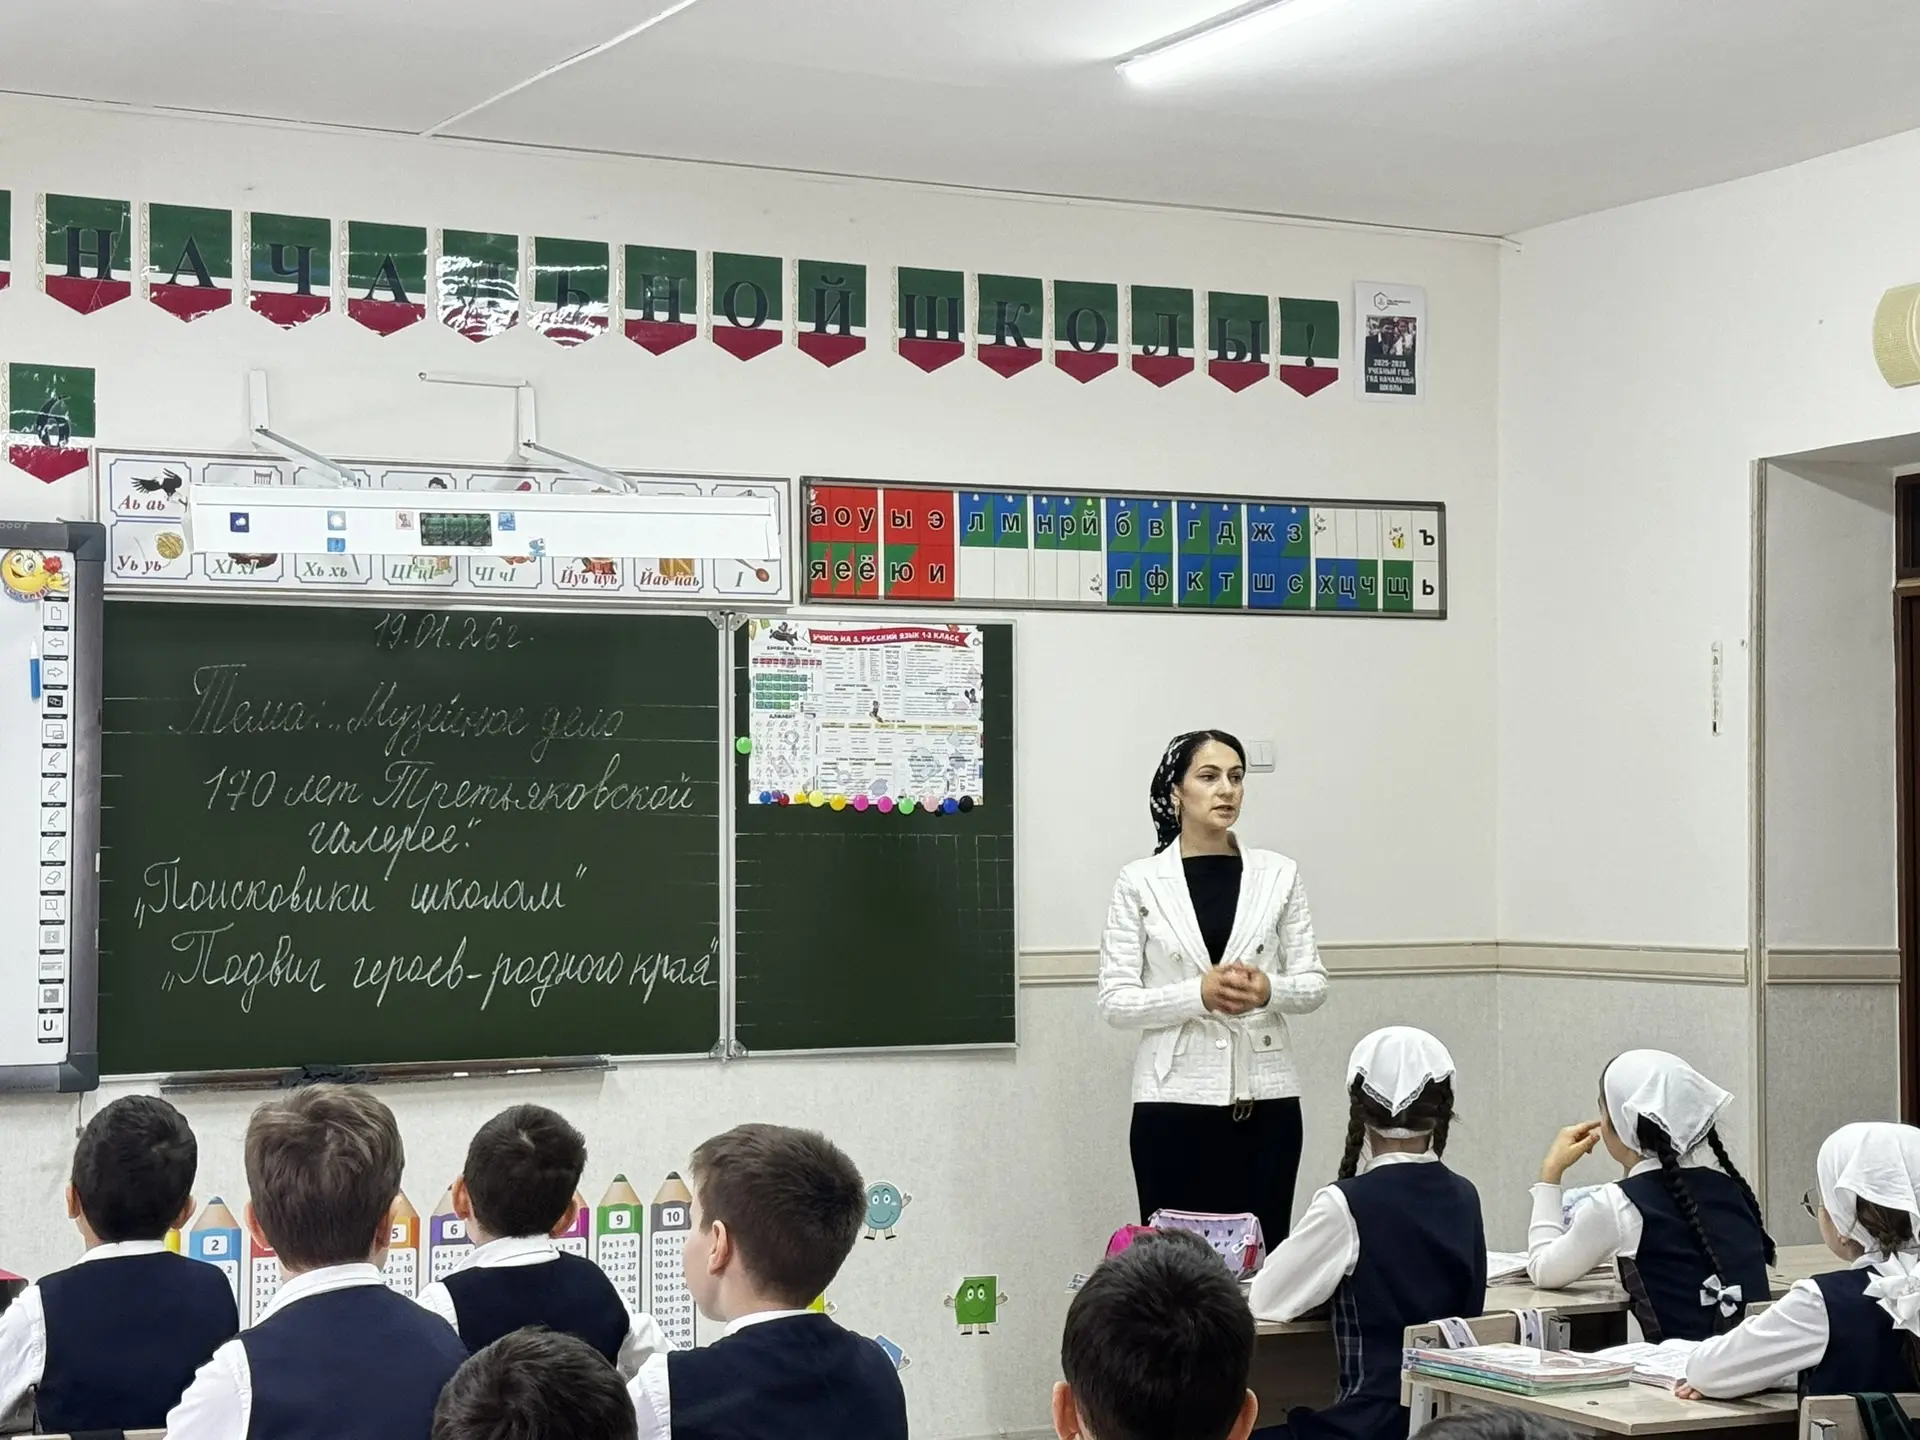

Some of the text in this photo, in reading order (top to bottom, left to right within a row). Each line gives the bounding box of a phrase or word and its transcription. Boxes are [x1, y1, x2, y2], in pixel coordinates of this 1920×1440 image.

[813, 634, 838, 642] УЧИСЬ
[840, 634, 851, 643] НА
[861, 632, 898, 643] РУССКИЙ
[899, 632, 919, 640] ЯЗЫК
[933, 633, 960, 642] КЛАСС
[203, 753, 695, 832] 170 лет Третьяковской
[616, 1214, 623, 1225] 9
[667, 1211, 680, 1222] 10
[392, 1228, 399, 1239] 5
[450, 1224, 458, 1235] 6
[211, 1239, 219, 1251] 2
[390, 1254, 394, 1262] 1
[406, 1253, 411, 1261] 5
[435, 1251, 440, 1259] 6
[450, 1250, 453, 1258] 1
[464, 1249, 470, 1257] 6
[602, 1252, 607, 1260] 9
[256, 1263, 261, 1271] 3
[272, 1262, 276, 1270] 1
[388, 1266, 393, 1274] 2
[403, 1265, 413, 1273] 10
[614, 1263, 619, 1271] 3
[627, 1262, 636, 1270] 27
[256, 1275, 261, 1283] 3
[388, 1278, 393, 1286] 3
[403, 1277, 412, 1286] 15
[256, 1288, 261, 1296] 3
[271, 1287, 276, 1295] 3
[669, 1306, 674, 1314] 7
